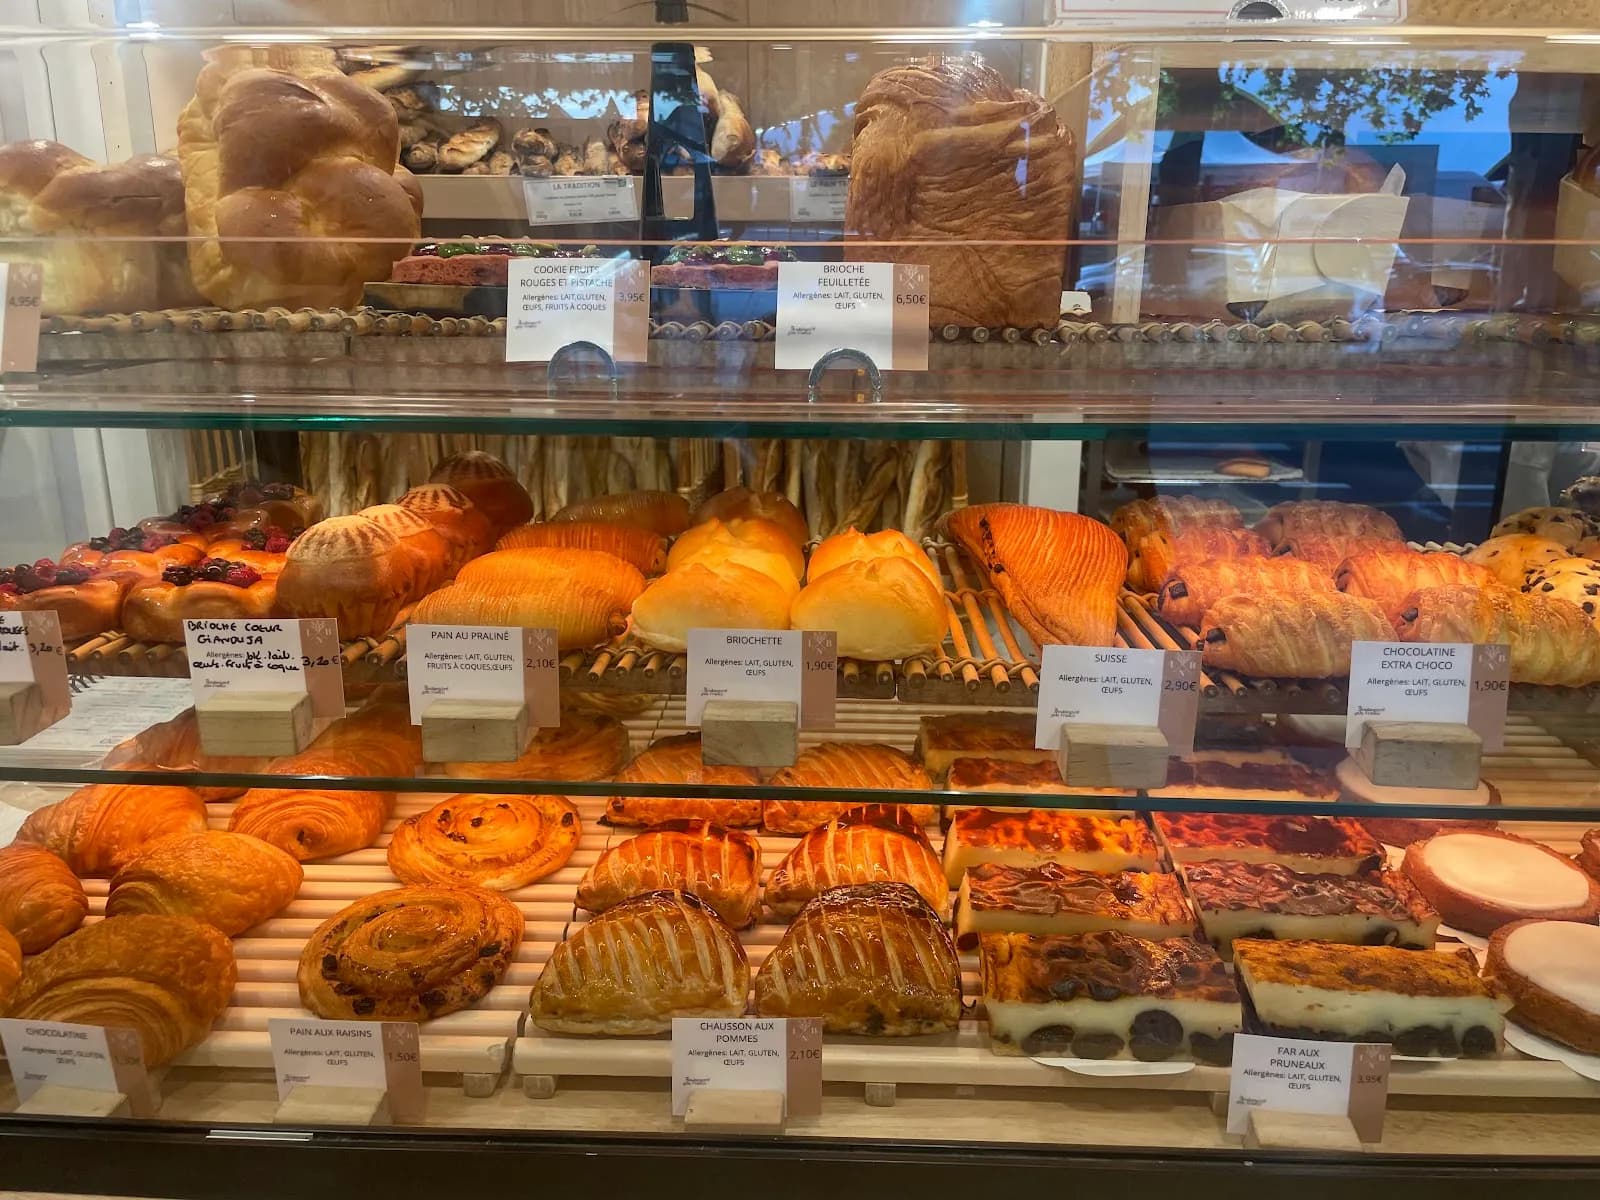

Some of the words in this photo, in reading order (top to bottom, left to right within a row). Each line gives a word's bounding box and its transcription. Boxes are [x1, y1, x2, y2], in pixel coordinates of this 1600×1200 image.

[534, 266, 566, 274] COOKIE
[569, 266, 600, 274] FRUITS
[824, 265, 864, 273] BRIOCHE
[520, 279, 556, 287] ROUGES
[571, 279, 612, 287] PISTACHE
[818, 278, 870, 287] FEUILLETÉE
[620, 292, 644, 302] 3,95€
[793, 292, 832, 300] Allergènes:
[834, 292, 851, 300] LAIT,
[853, 292, 884, 300] GLUTEN,
[896, 295, 926, 305] 6,50€
[432, 631, 452, 639] PAIN
[472, 631, 509, 640] PRALINÉ
[727, 636, 782, 645] BRIOCHETTE
[206, 652, 244, 660] Allergènes:
[1383, 648, 1455, 656] CHOCOLATINE
[1095, 654, 1127, 663] SUISSE
[526, 659, 556, 669] 2,10€
[705, 659, 742, 667] Allergènes:
[763, 660, 793, 668] GLUTEN,
[806, 661, 834, 671] 1,90€
[1382, 661, 1412, 669] EXTRA
[1416, 662, 1452, 670] CHOCO
[1059, 674, 1098, 683] Allergènes:
[1367, 678, 1410, 686] Allergènes:
[1433, 679, 1466, 687] GLUTEN,
[1164, 681, 1197, 691] 2,90€
[1475, 681, 1507, 692] 1,90€
[700, 1022, 752, 1031] CHAUSSON
[26, 1028, 88, 1039] CHOCOLATINE
[290, 1028, 312, 1036] PAIN
[716, 1035, 758, 1043] POMMES
[790, 1051, 820, 1060] 2,10€
[1278, 1047, 1296, 1056] FAR
[388, 1053, 417, 1062] 1,50€
[1270, 1059, 1325, 1069] PRUNEAUX
[1243, 1069, 1285, 1079] Allergènes:
[1288, 1073, 1306, 1081] LAIT,
[1308, 1075, 1341, 1083] GLUTEN,
